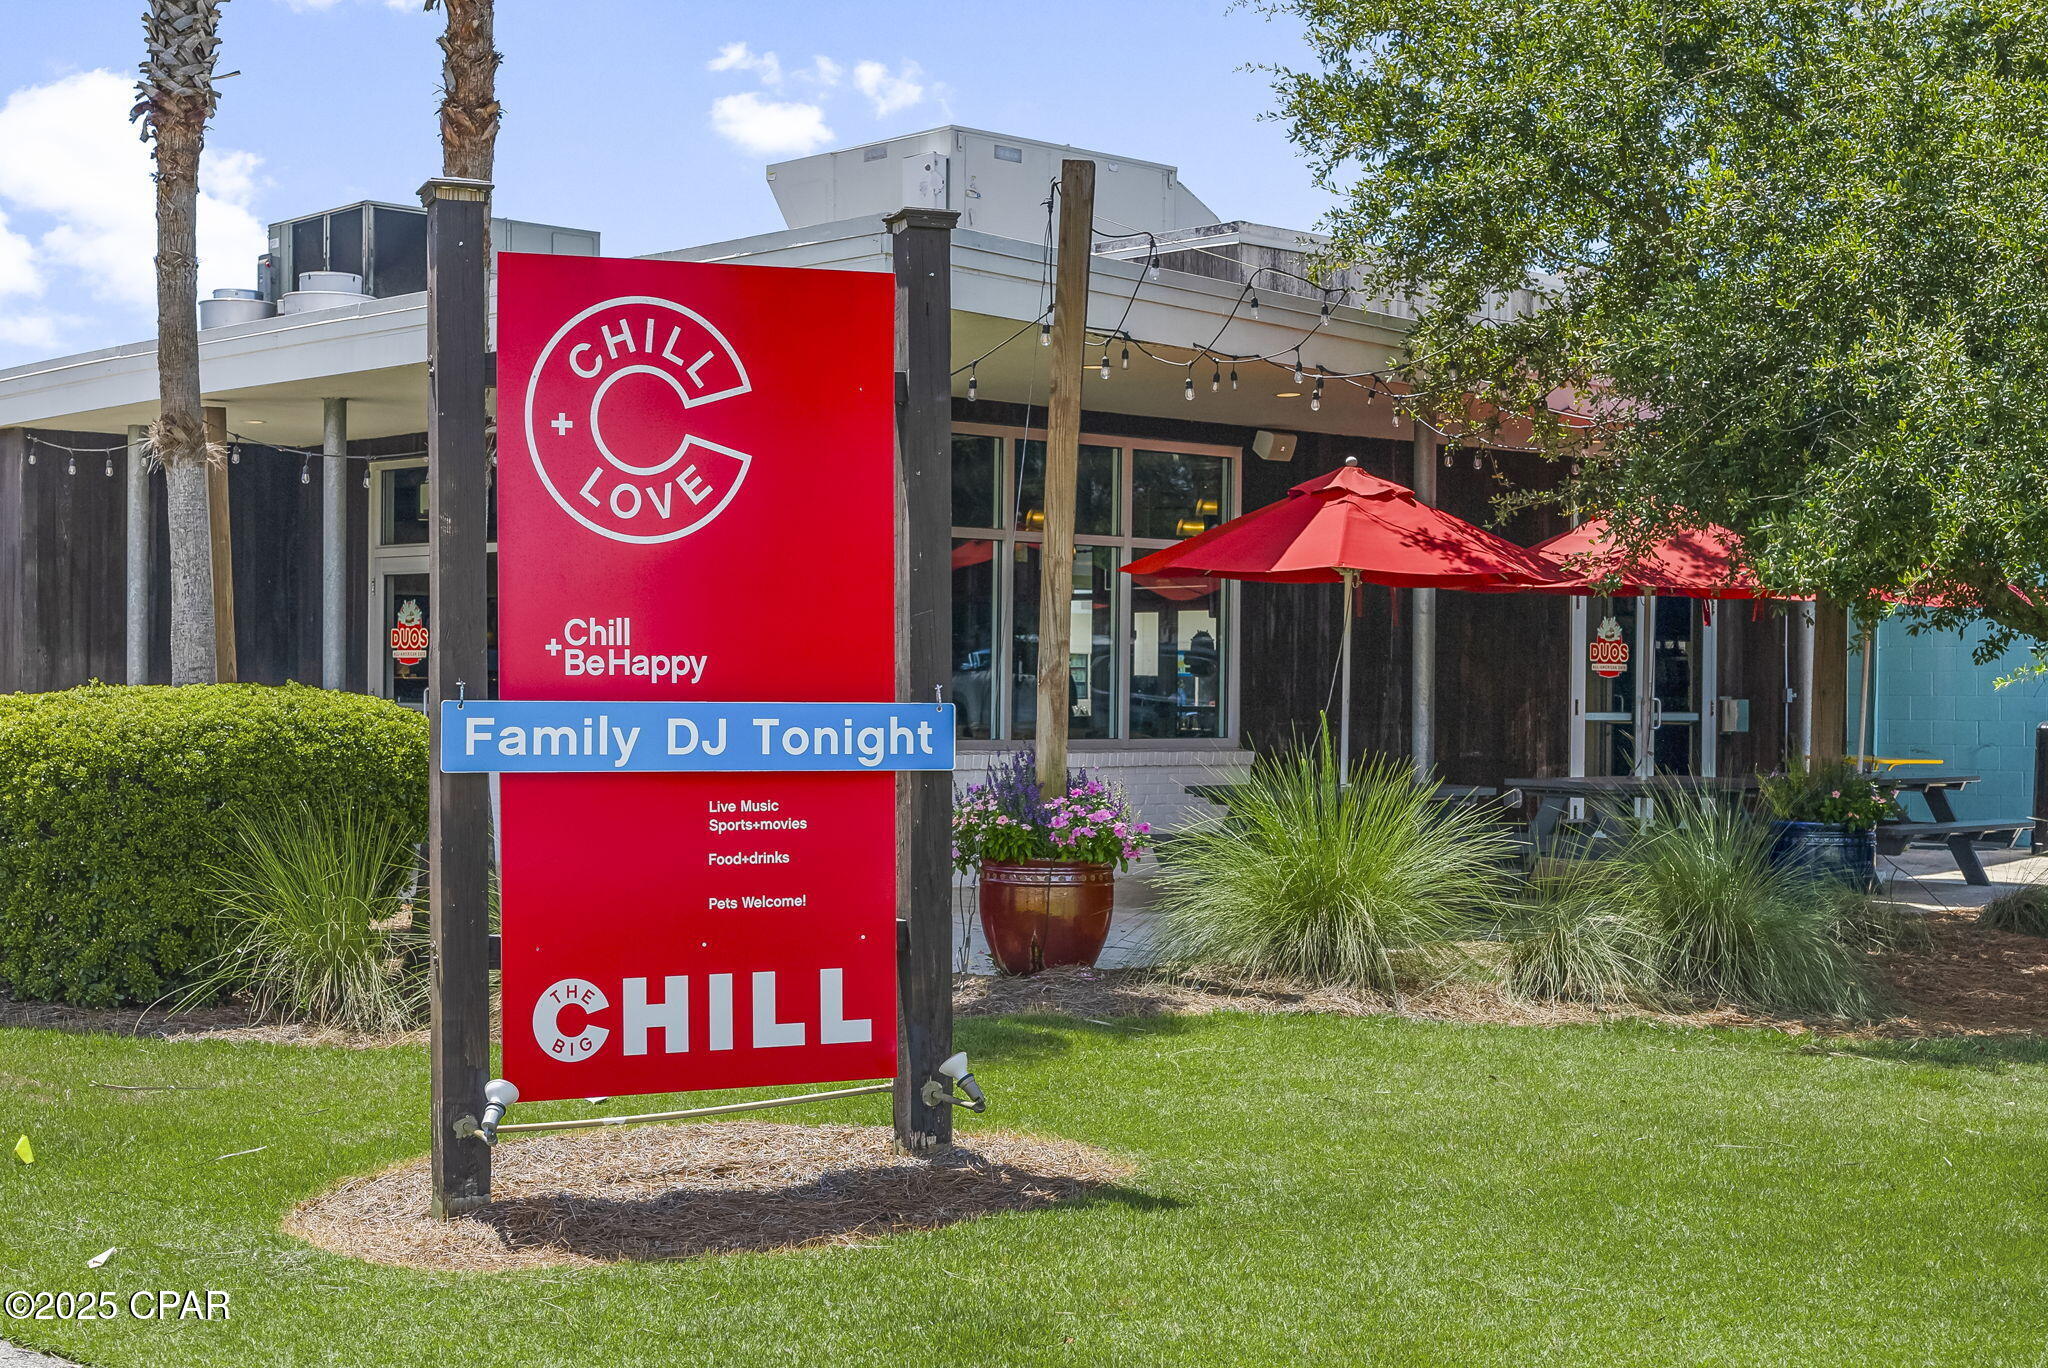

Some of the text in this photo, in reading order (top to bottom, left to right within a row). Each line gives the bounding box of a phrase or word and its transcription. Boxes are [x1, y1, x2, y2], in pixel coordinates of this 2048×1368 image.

[569, 318, 715, 389] CHILL
[578, 463, 714, 520] LOVE
[391, 628, 429, 649] DUOS
[564, 617, 631, 647] Chill
[1590, 643, 1629, 662] DUOS
[466, 715, 933, 768] Family DJ Tonight
[708, 800, 780, 813] Live Music
[708, 817, 808, 835] Sports+movies
[708, 851, 790, 866] Food+drinks
[708, 894, 807, 910] Pets Welcome!
[549, 984, 596, 1006] THE
[551, 1037, 593, 1057] BIG
